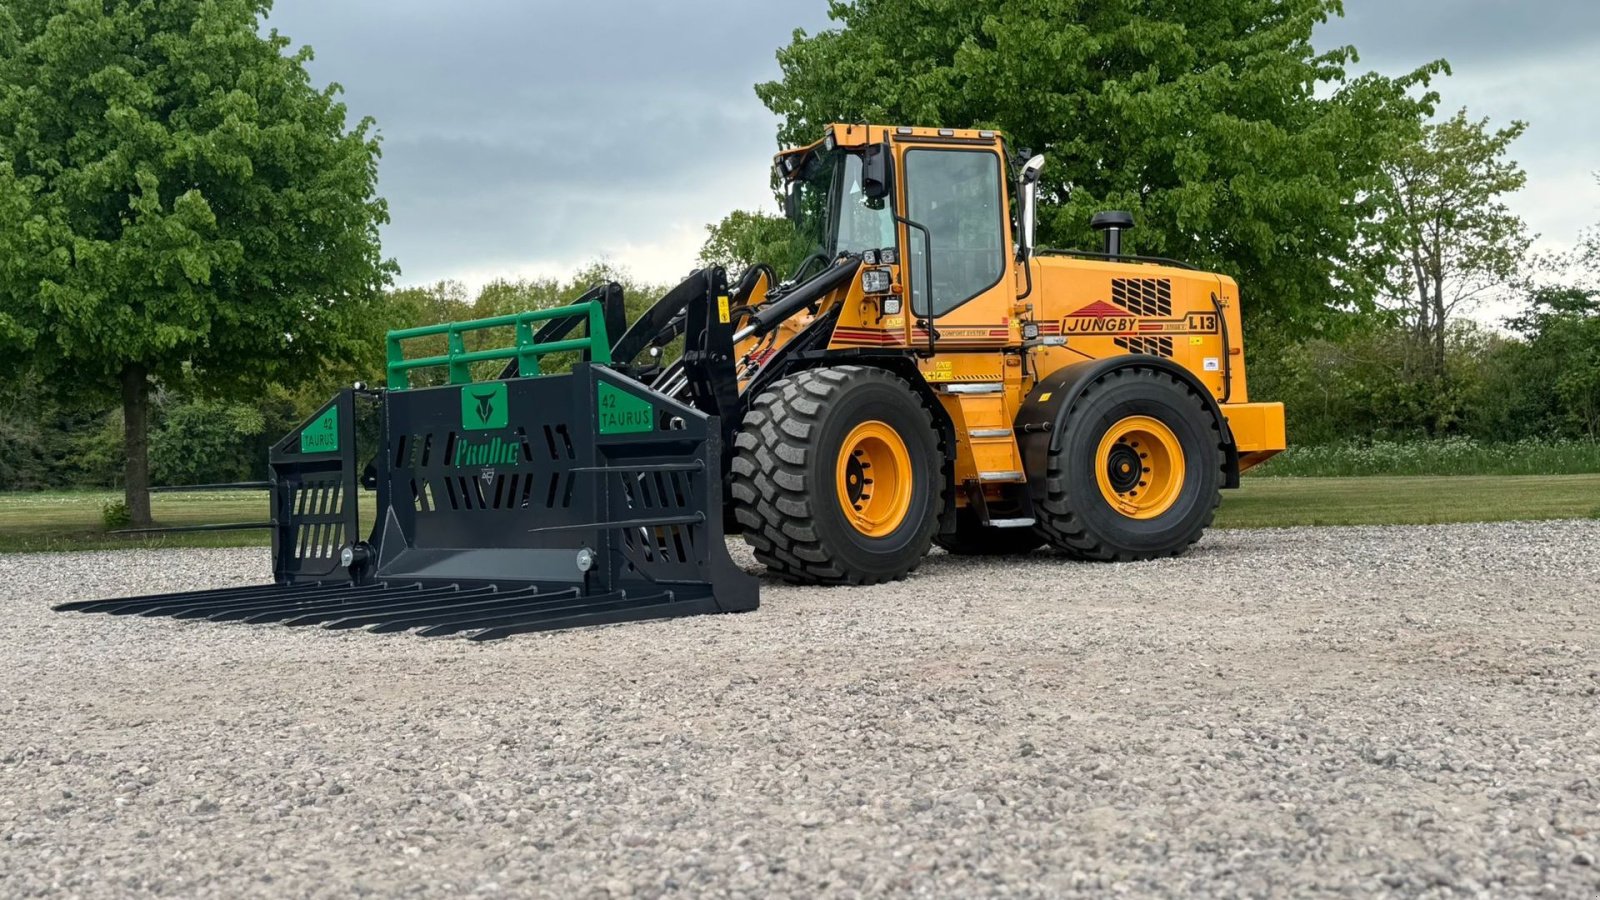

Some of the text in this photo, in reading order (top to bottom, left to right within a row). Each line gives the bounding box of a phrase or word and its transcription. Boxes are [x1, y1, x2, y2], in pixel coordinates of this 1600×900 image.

[602, 394, 616, 408] 42
[324, 417, 333, 430] 42
[602, 410, 649, 427] TAURUS
[305, 433, 334, 447] TAURUS
